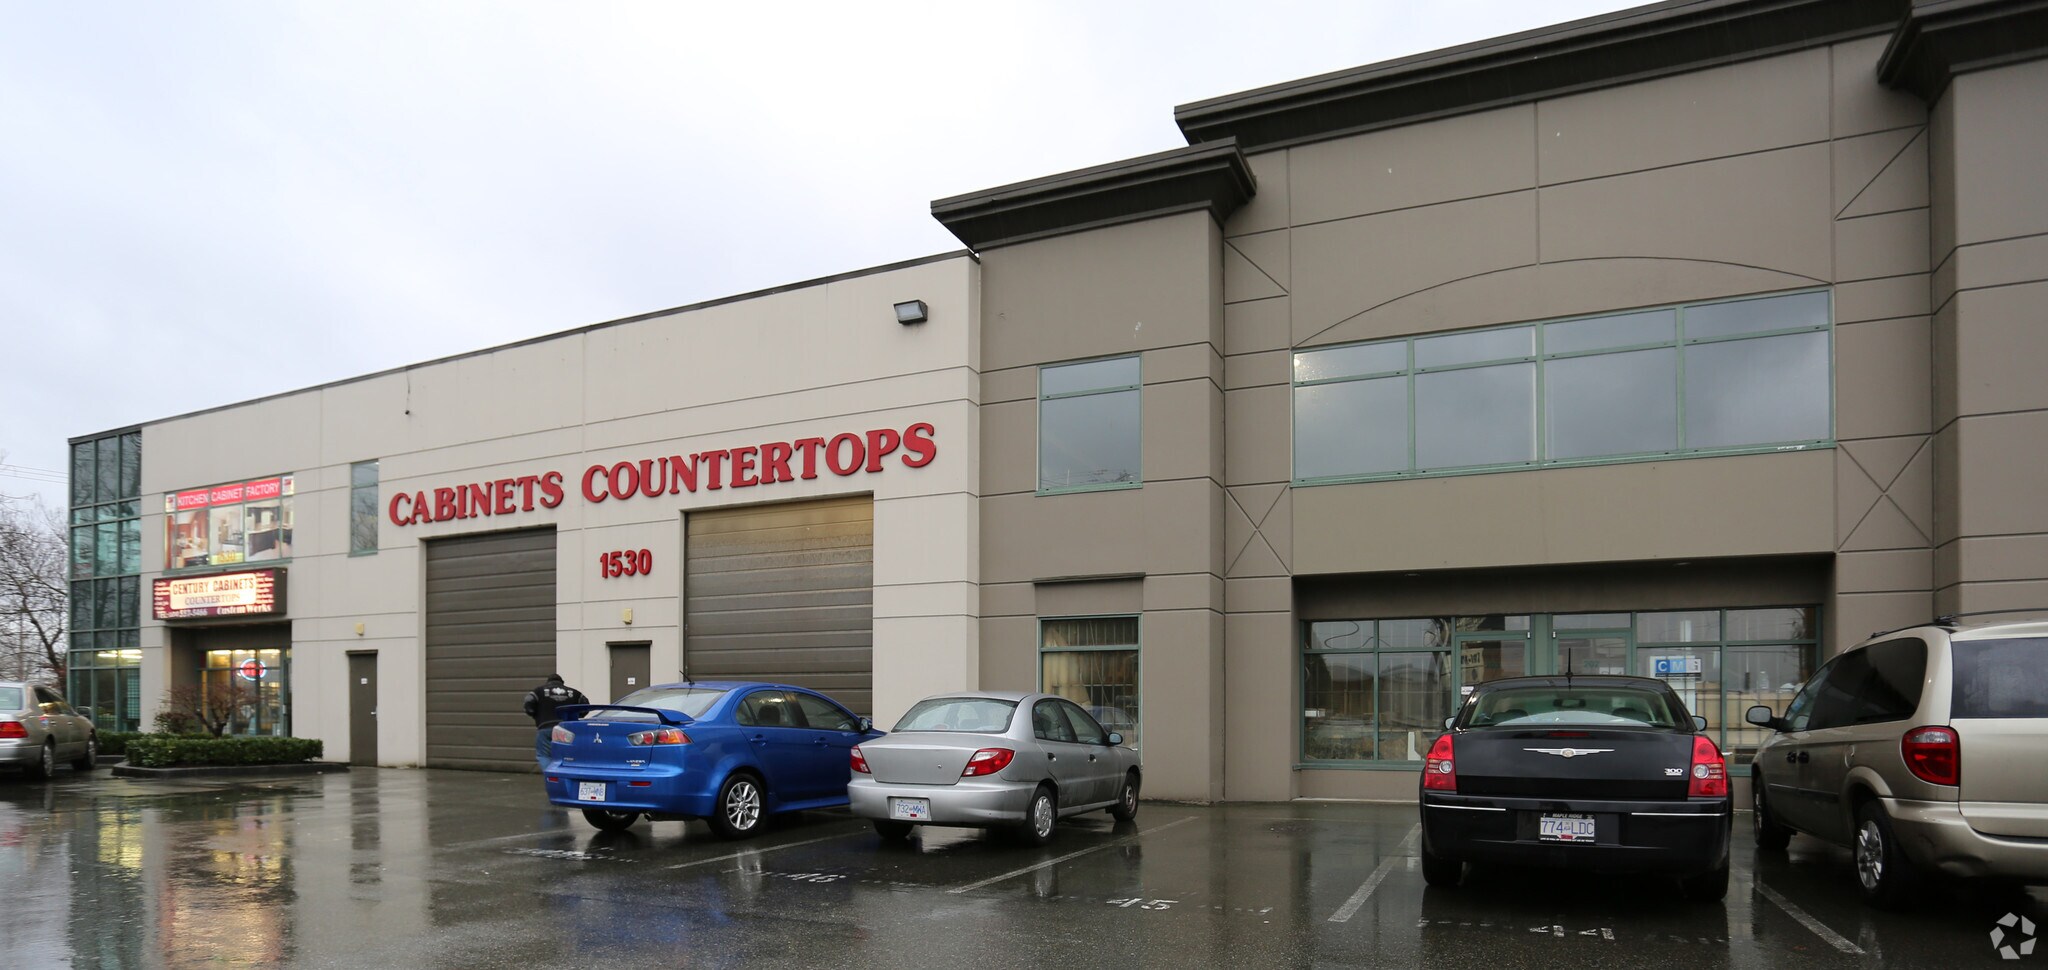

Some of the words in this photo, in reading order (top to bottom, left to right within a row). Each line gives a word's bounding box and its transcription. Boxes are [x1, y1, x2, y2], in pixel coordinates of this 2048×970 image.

[389, 471, 564, 527] CABINETS
[582, 422, 937, 500] COUNTERTOPS
[177, 492, 208, 507] KITCHEN
[211, 487, 243, 502] CABINET
[246, 482, 280, 497] FACTORY
[600, 548, 653, 579] 1530
[173, 581, 209, 595] CENTURY
[213, 577, 254, 592] CABINETS
